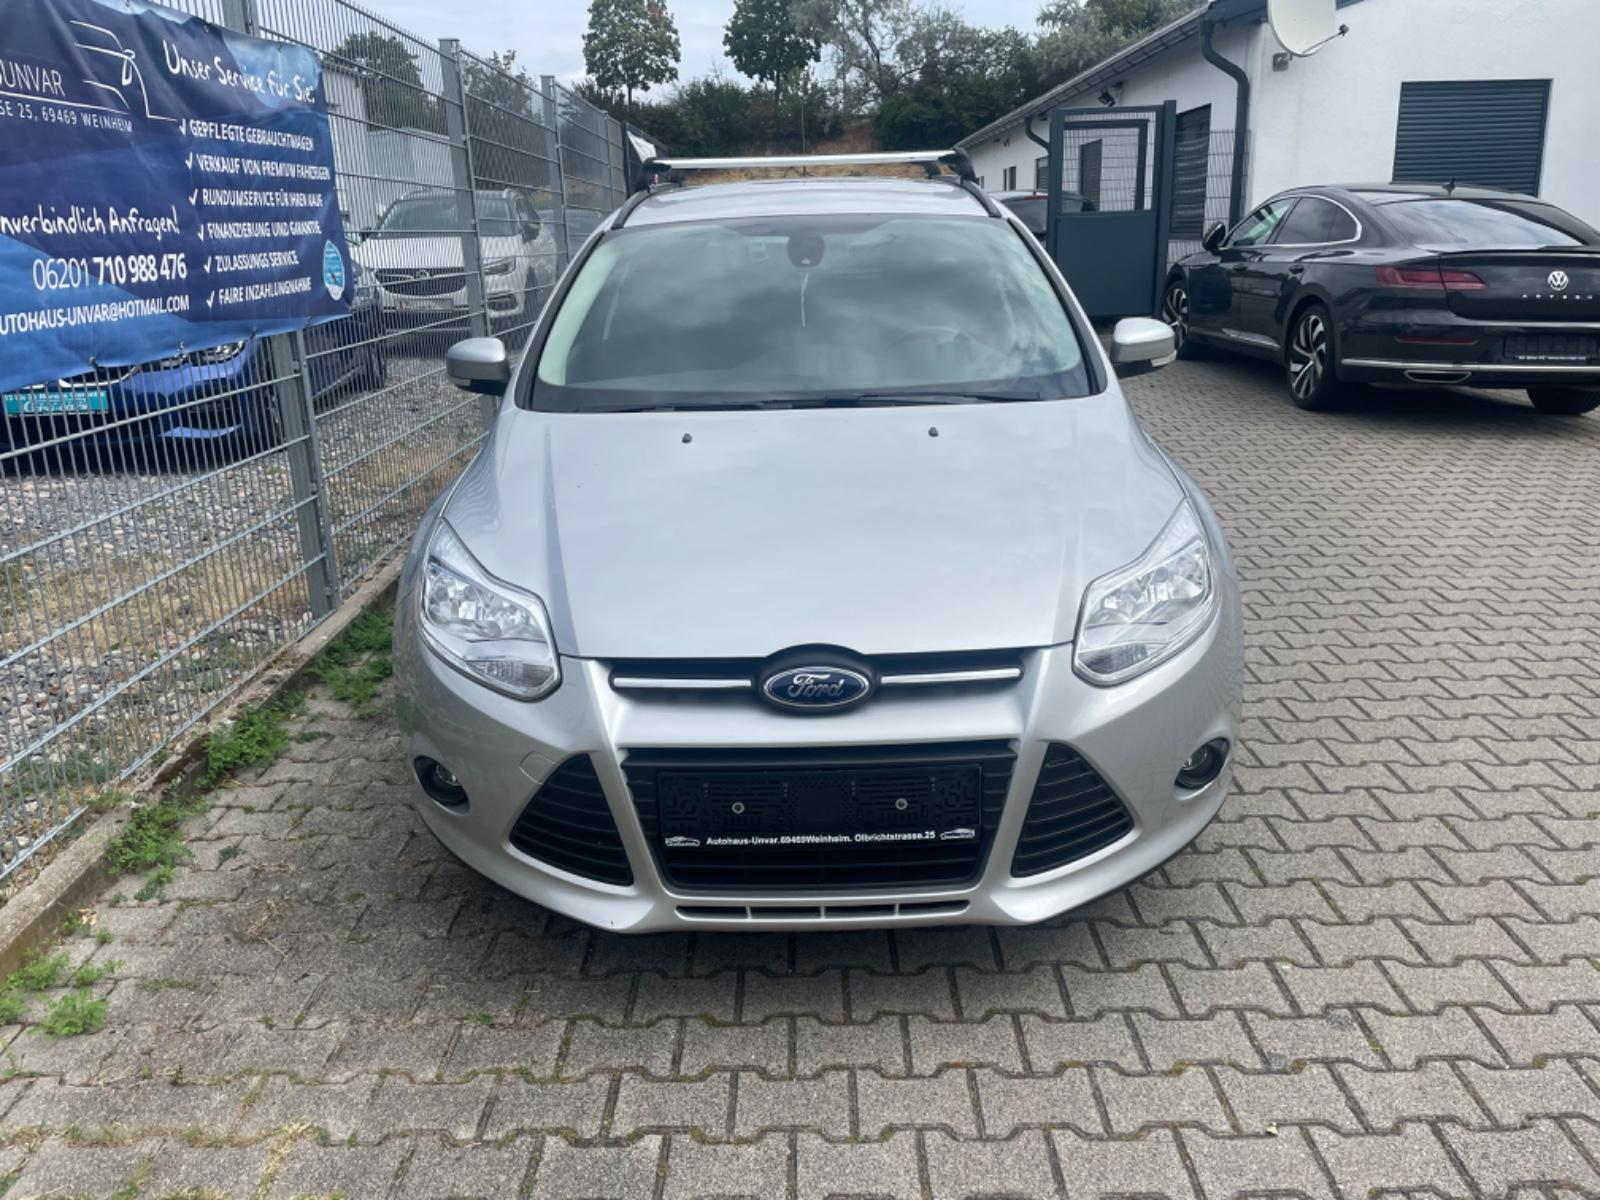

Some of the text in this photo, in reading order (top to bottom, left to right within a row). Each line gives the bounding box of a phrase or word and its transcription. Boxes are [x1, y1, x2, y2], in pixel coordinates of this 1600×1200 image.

[162, 38, 315, 104] Unser Service für Sie.
[0, 100, 13, 117] SE
[42, 105, 77, 125] 69469
[81, 112, 133, 133] WEINHEIM
[189, 119, 314, 151] GEPFLEGTE GEBRAUCHTWAGEN
[196, 153, 240, 174] VERKAUF
[242, 158, 261, 176] VON
[261, 159, 296, 178] PREMIUM
[202, 189, 275, 207] RUNDUMSERVICE
[0, 204, 180, 241] nverbindlich Anfragen!
[207, 220, 322, 240] FINANZIERUNG UND GARANTIE
[32, 252, 187, 291] 06201 710 988 476
[215, 250, 299, 273] ZULASSUNGS SERVICE
[218, 286, 244, 305] FAIRE
[0, 294, 189, 335] UTOHAUS-UNVAR@HOTMAIL.COM
[787, 672, 846, 698] Ford
